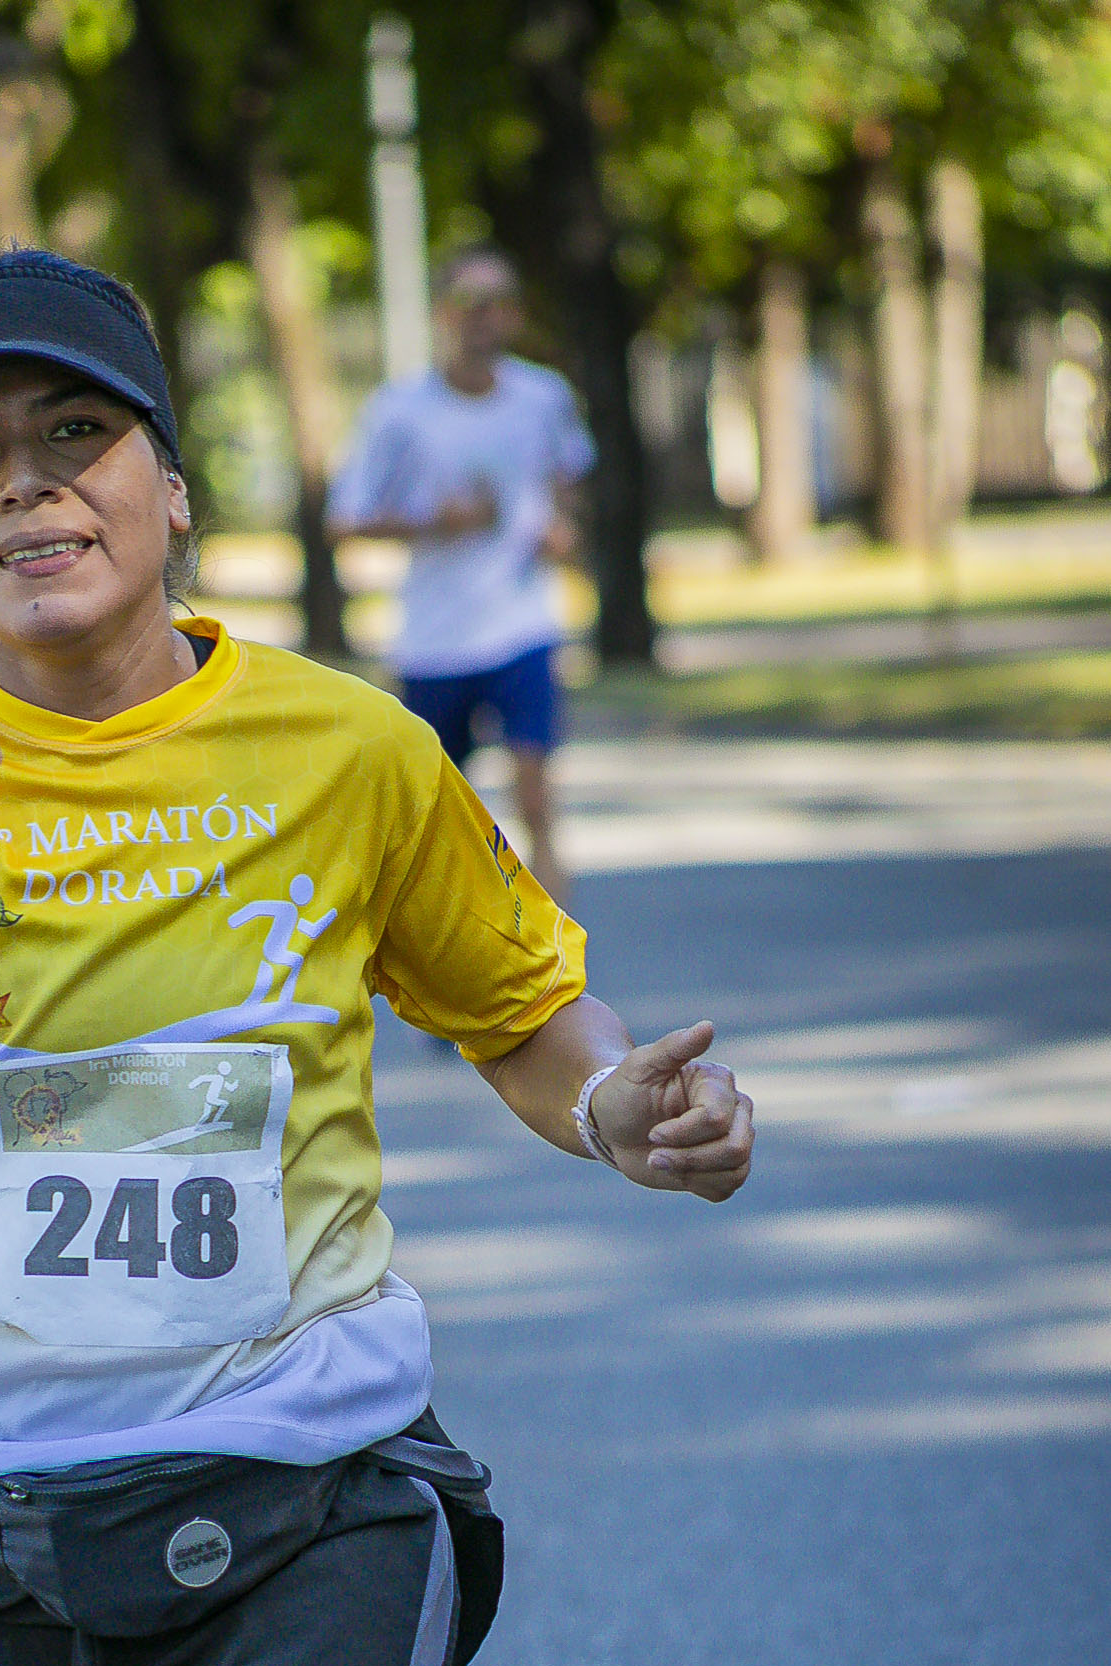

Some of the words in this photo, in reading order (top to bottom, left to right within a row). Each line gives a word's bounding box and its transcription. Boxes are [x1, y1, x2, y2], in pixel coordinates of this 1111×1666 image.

[26, 793, 278, 856] MARATÓN
[19, 861, 232, 906] DORADA
[107, 1071, 170, 1086] DORADA
[23, 1174, 239, 1280] 248
